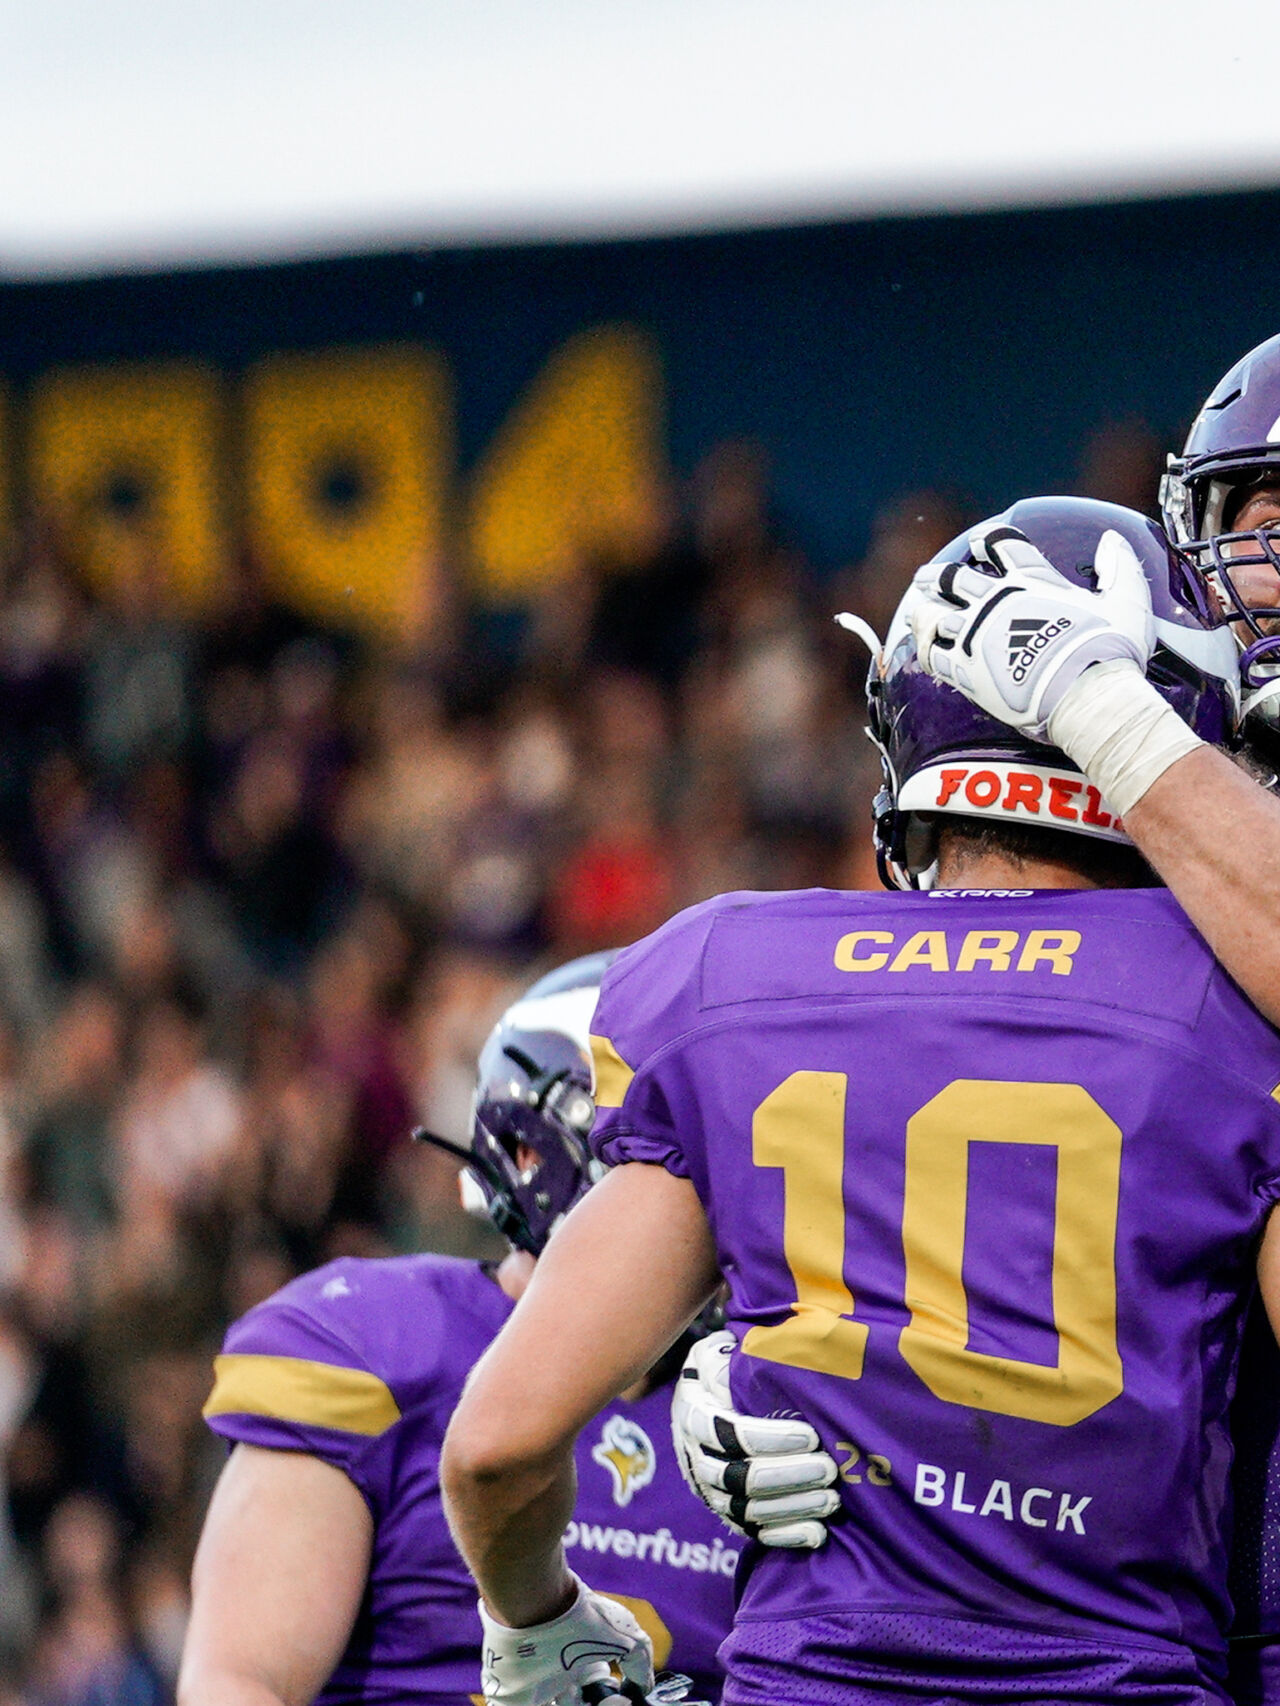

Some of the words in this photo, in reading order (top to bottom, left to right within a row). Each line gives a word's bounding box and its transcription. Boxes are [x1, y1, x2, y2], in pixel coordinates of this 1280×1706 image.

[1012, 617, 1072, 682] adidas
[935, 769, 1127, 833] FOREL
[833, 929, 1082, 976] CARR
[741, 1069, 1124, 1427] 10
[914, 1462, 1094, 1535] BLACK
[561, 1520, 740, 1577] owerfusio
